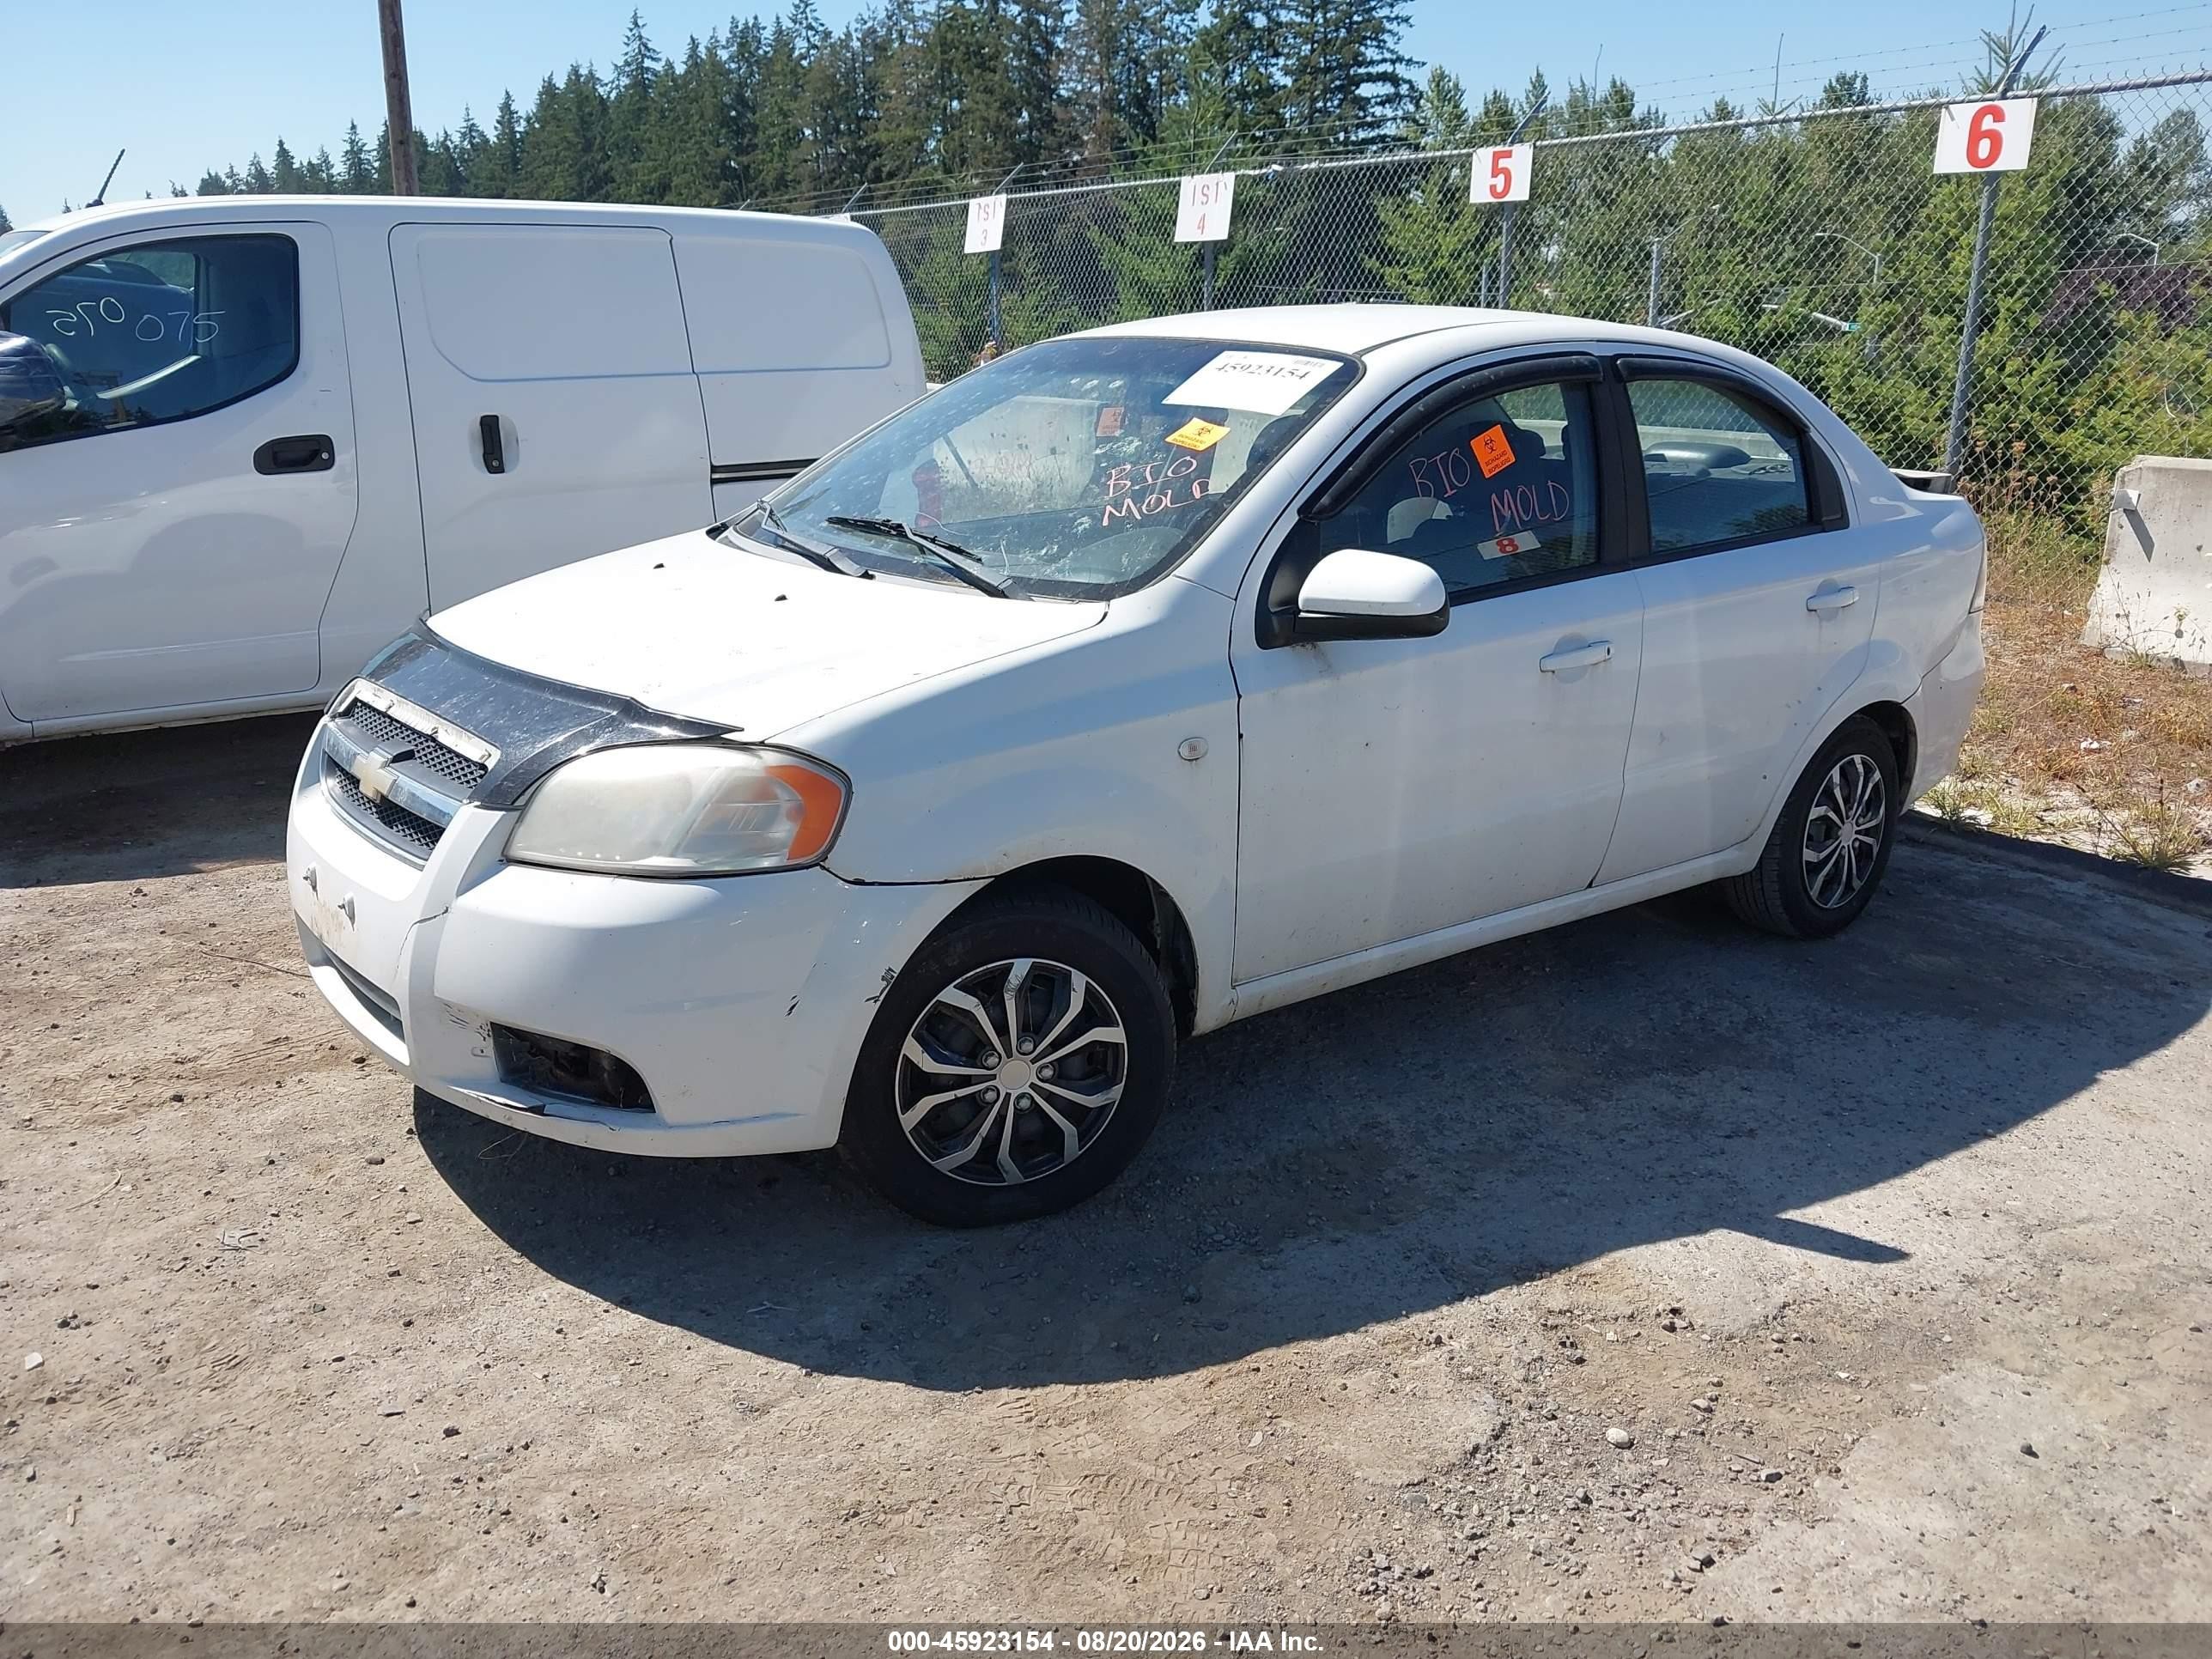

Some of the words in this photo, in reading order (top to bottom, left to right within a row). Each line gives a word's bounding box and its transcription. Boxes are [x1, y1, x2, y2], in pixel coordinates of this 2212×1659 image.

[1966, 104, 2007, 169] 6
[1489, 149, 1514, 199] 5
[1196, 213, 1207, 235] 4
[135, 310, 226, 343] 075
[1103, 456, 1198, 498] BIO
[1409, 447, 1471, 498] BIO
[1491, 480, 1570, 532] MOLD
[1496, 537, 1520, 555] 8
